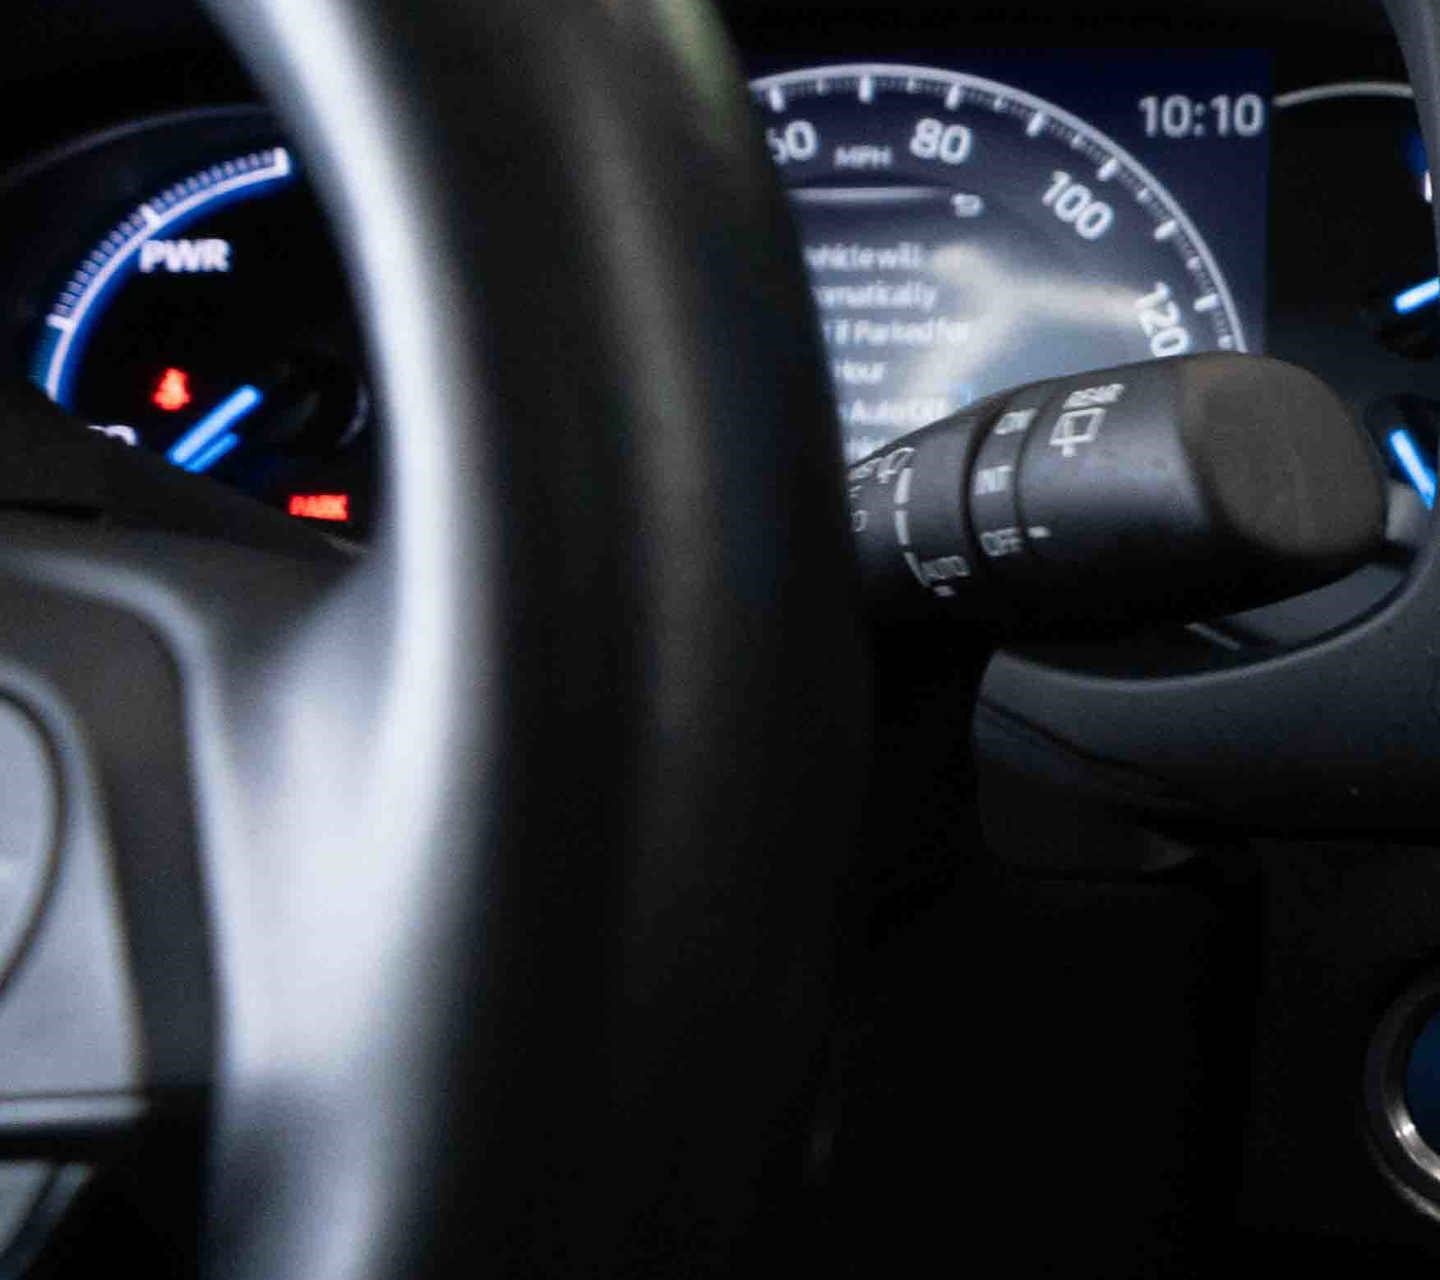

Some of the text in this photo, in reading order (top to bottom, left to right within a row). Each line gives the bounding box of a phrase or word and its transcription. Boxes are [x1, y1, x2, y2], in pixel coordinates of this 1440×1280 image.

[1139, 93, 1264, 138] 10:10
[909, 118, 972, 164] 80
[1041, 170, 1115, 241] 100
[139, 238, 230, 273] PWR
[1133, 280, 1193, 359] 120
